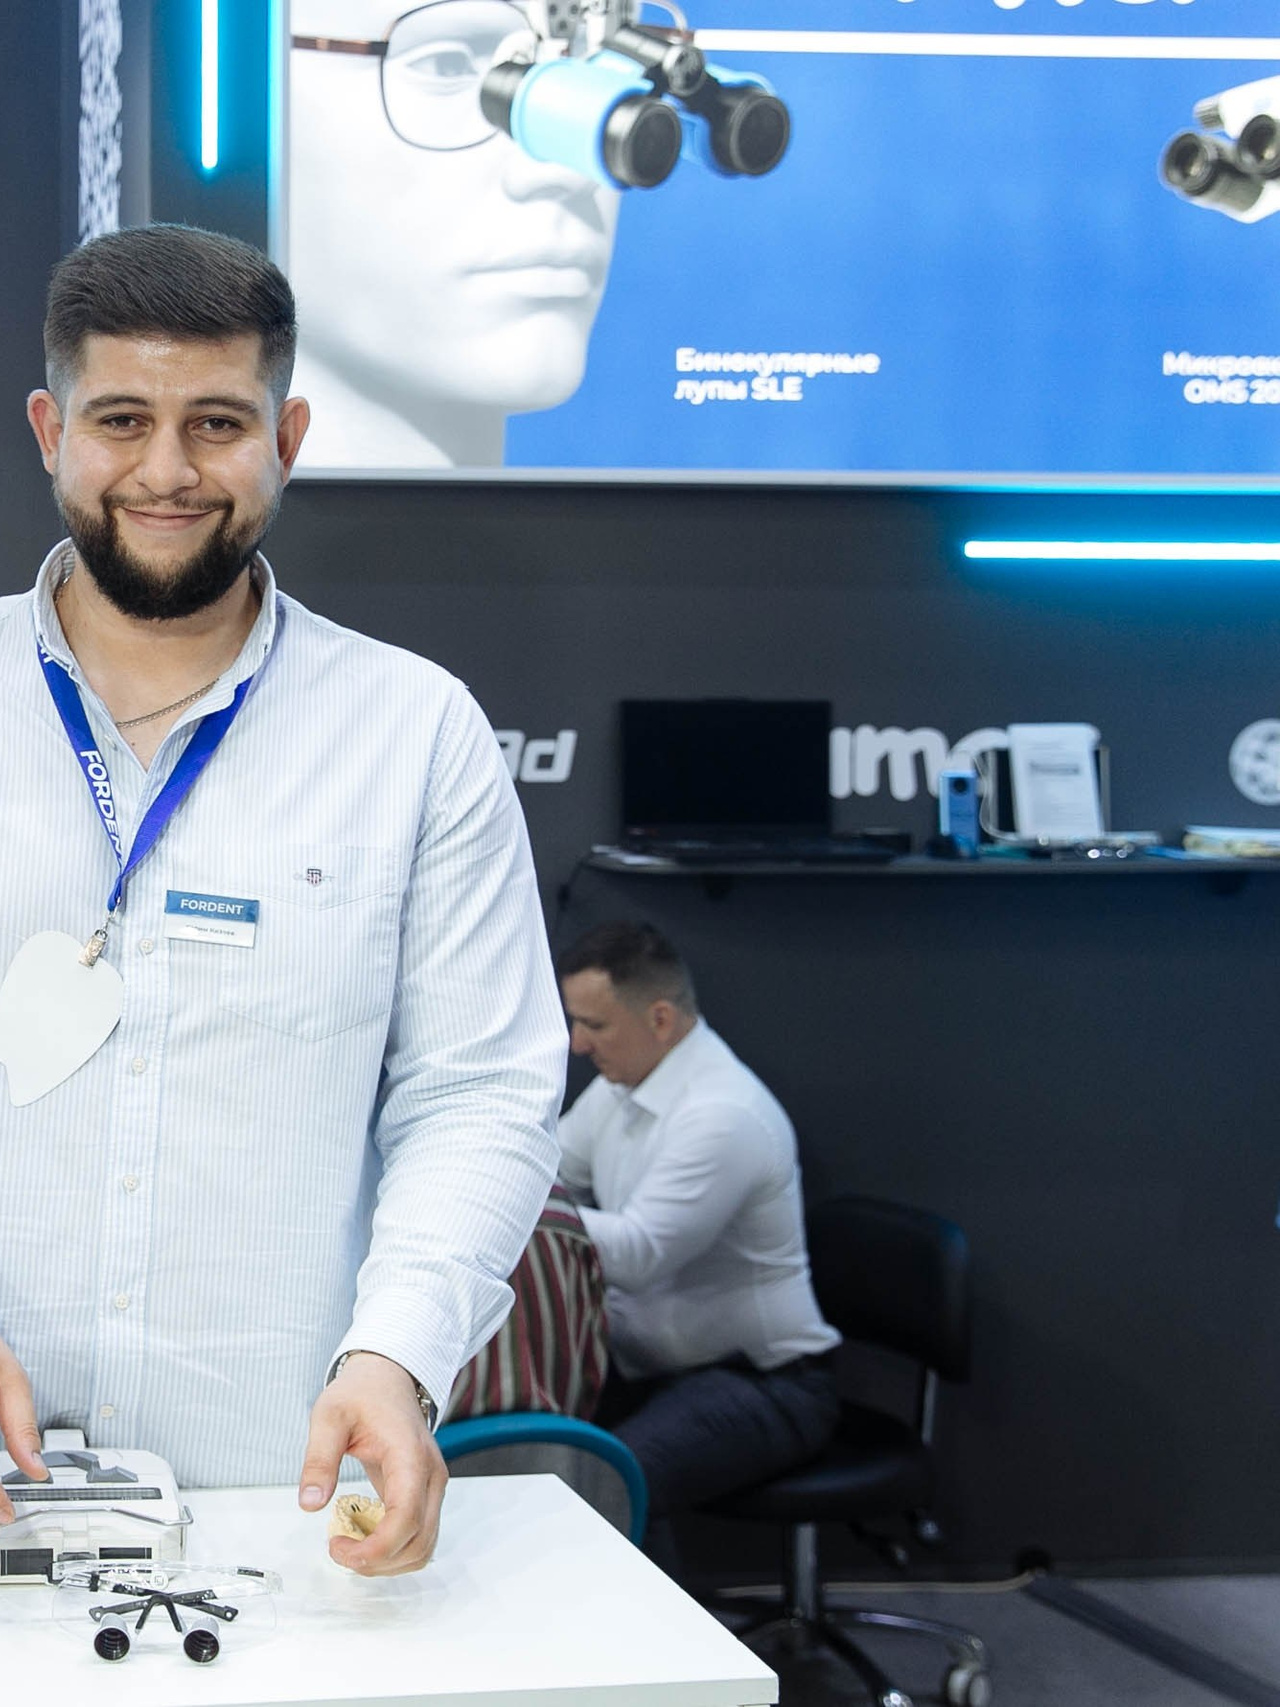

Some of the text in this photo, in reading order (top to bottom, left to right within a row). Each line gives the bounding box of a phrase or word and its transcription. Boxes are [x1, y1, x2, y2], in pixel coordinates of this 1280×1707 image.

[675, 346, 882, 379] Бинокулярные
[673, 375, 804, 406] лупы SLE
[80, 750, 123, 858] FORDEN
[180, 898, 245, 916] FORDENT
